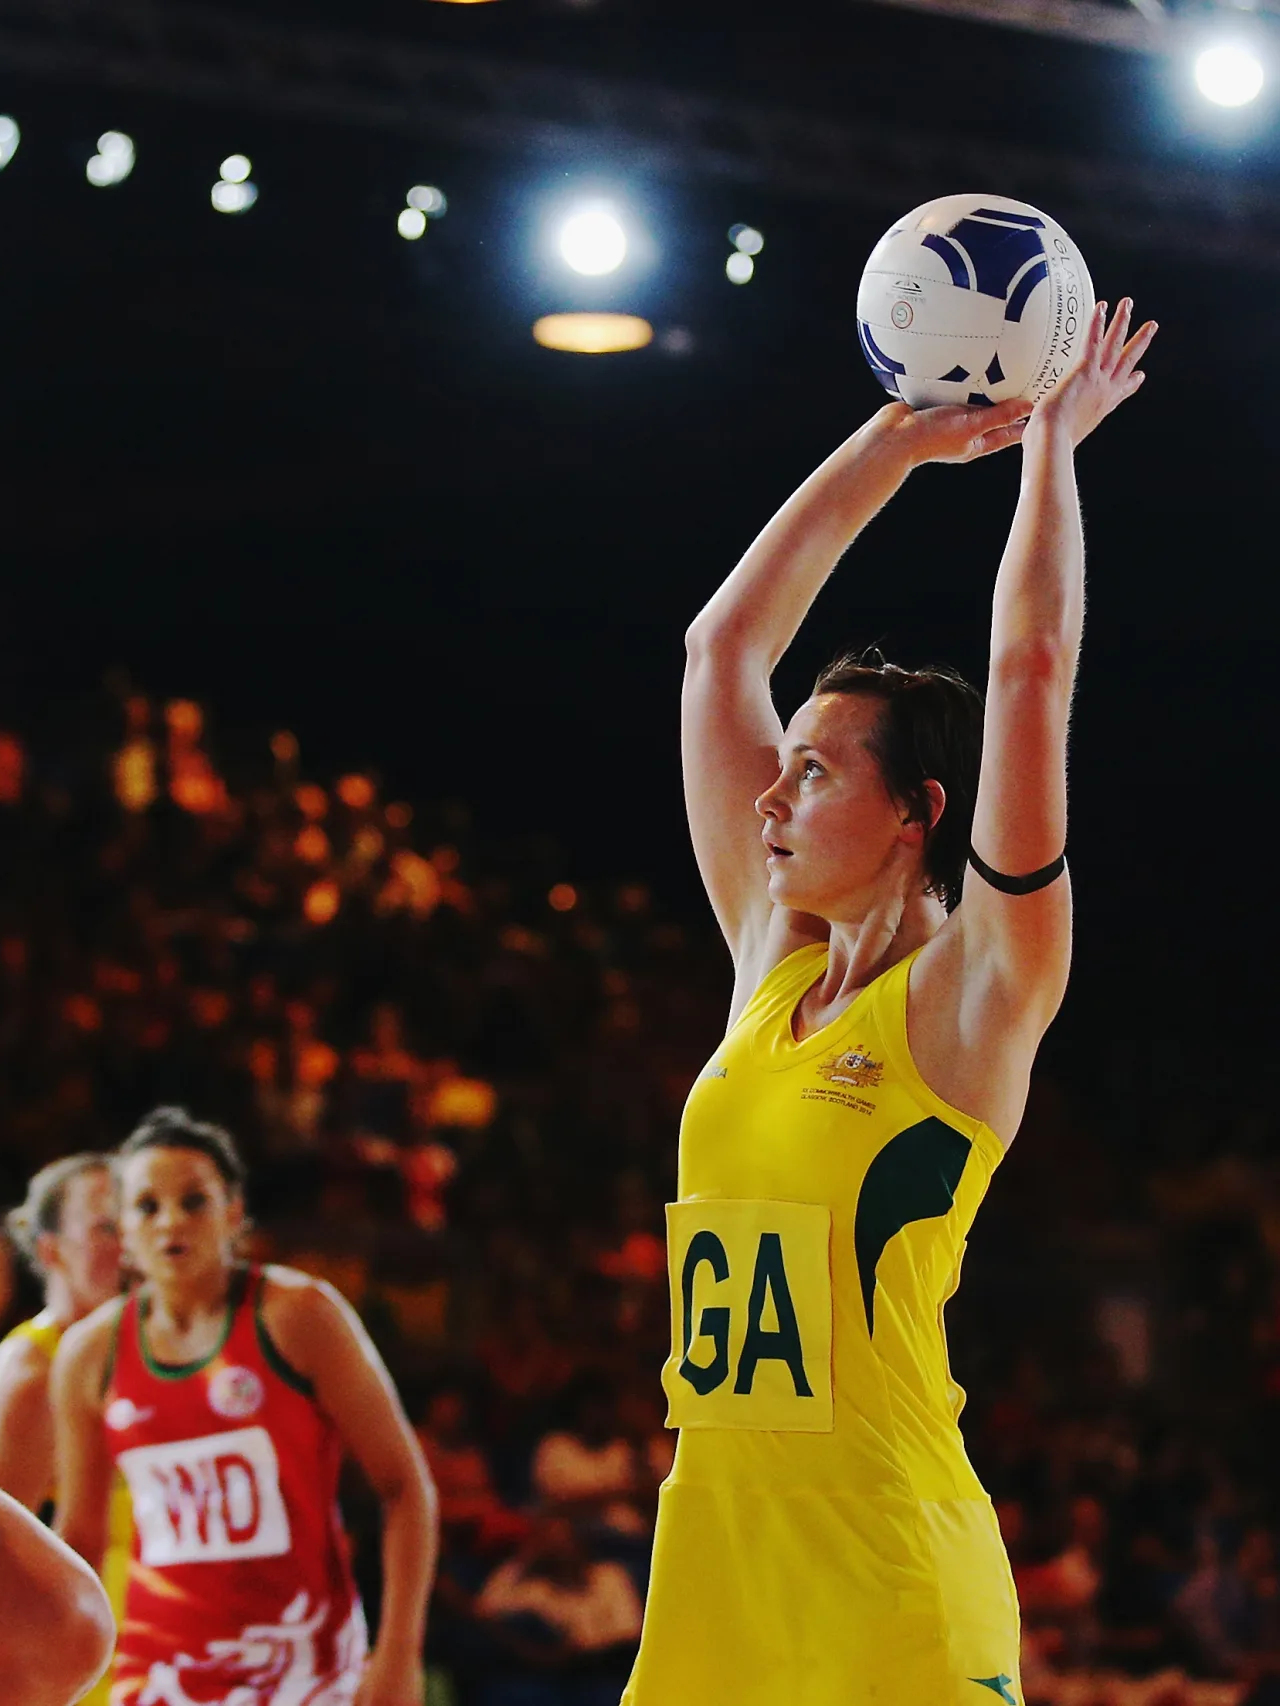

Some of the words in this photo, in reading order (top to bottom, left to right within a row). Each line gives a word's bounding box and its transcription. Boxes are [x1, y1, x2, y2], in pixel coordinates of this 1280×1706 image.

[1049, 272, 1063, 355] COMMONWEALTH
[1054, 239, 1078, 357] GLASGOW
[1033, 359, 1052, 388] GAMES
[679, 1230, 814, 1397] GA
[151, 1453, 261, 1546] WD
